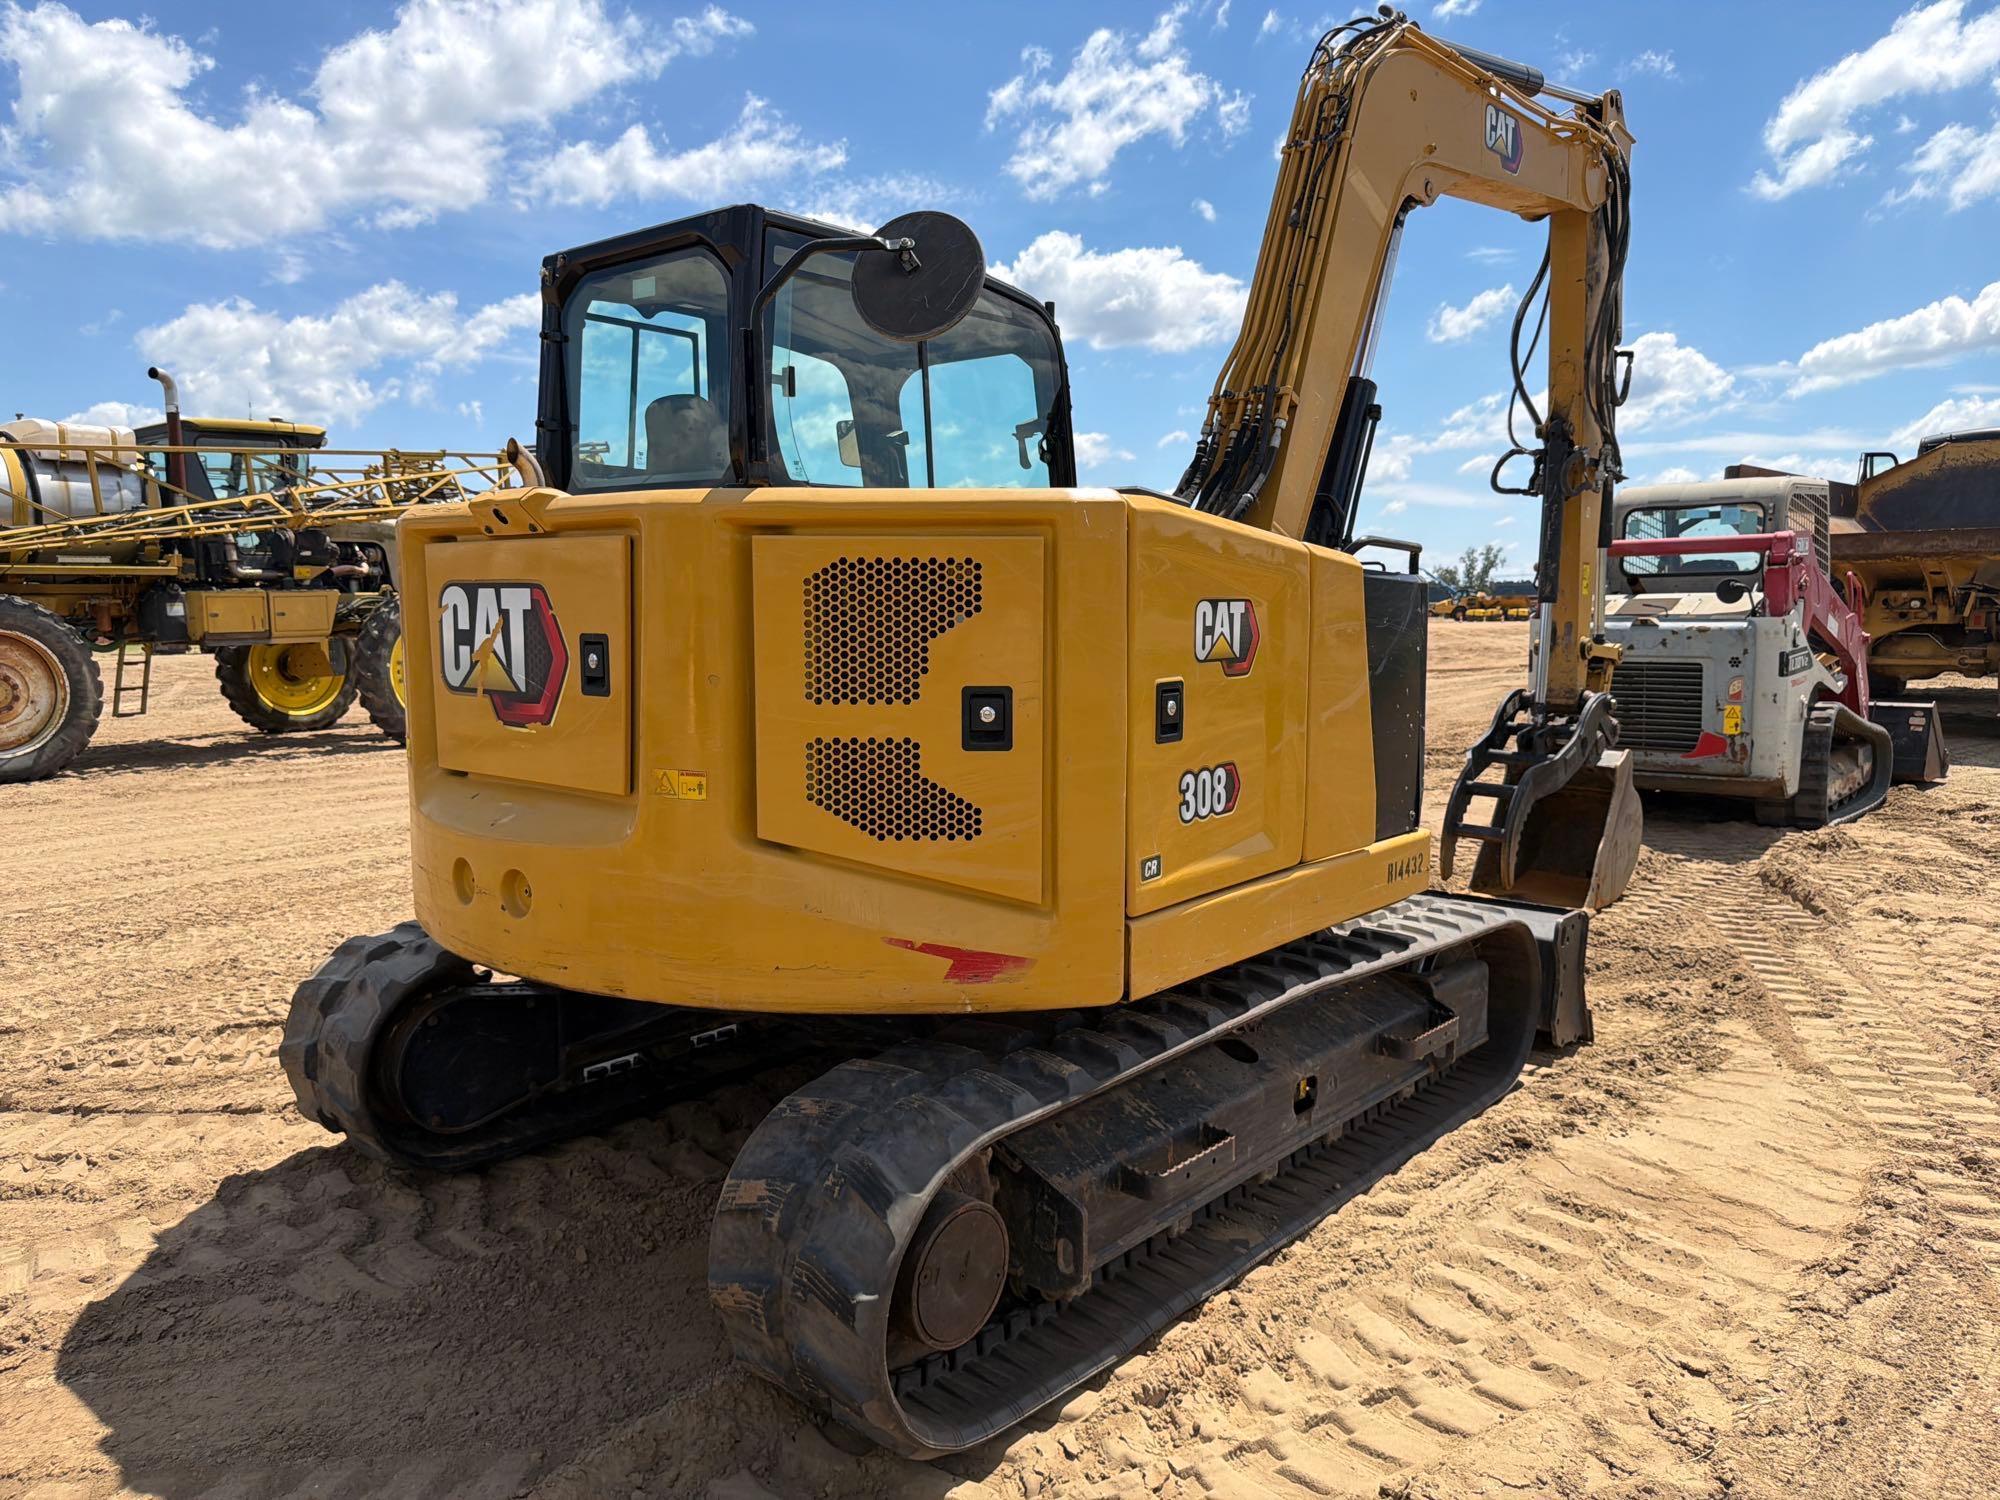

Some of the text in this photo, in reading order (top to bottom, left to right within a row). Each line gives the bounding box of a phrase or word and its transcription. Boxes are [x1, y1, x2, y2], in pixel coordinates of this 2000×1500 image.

[1486, 104, 1516, 159] CAT
[441, 585, 532, 693] CAT
[1195, 600, 1246, 661] CAT
[1180, 767, 1227, 821] 308
[1144, 859, 1158, 877] CR
